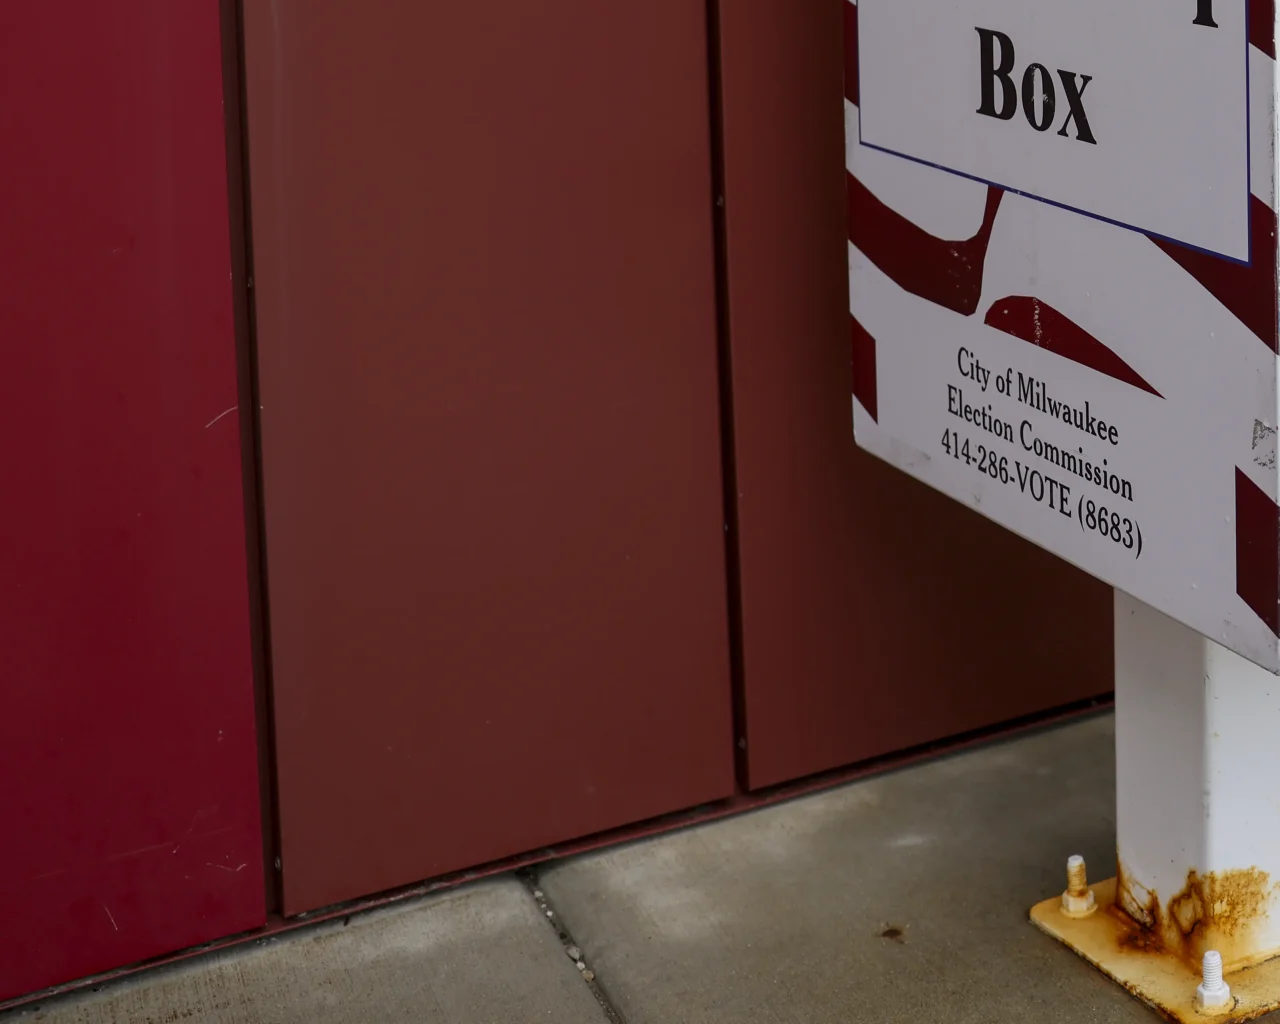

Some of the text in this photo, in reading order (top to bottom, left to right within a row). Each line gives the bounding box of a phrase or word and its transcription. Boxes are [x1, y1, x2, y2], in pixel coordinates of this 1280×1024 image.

[974, 25, 1098, 145] Box
[947, 384, 1134, 502] Election Commission
[957, 346, 1119, 446] City of Milwaukee
[941, 428, 1143, 560] 414-286-VOTE (8683)
